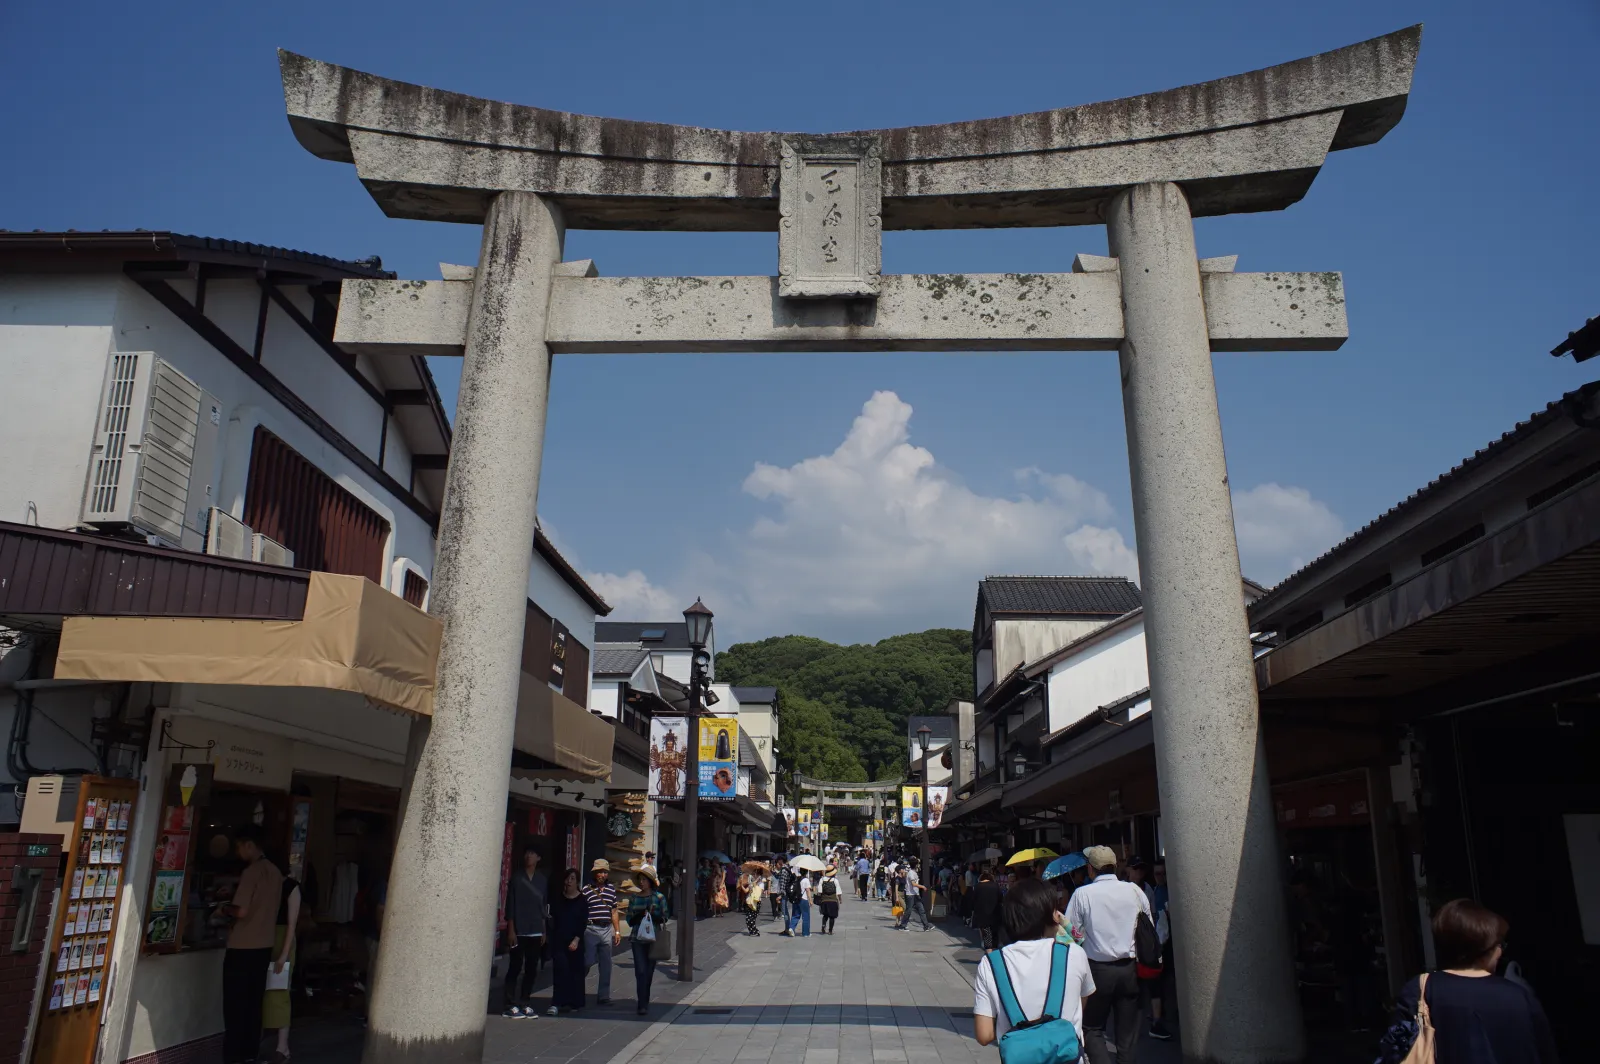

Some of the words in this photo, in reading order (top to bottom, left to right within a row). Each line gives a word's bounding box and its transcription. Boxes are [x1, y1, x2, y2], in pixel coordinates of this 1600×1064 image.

[226, 758, 264, 774] ソフトクリーム
